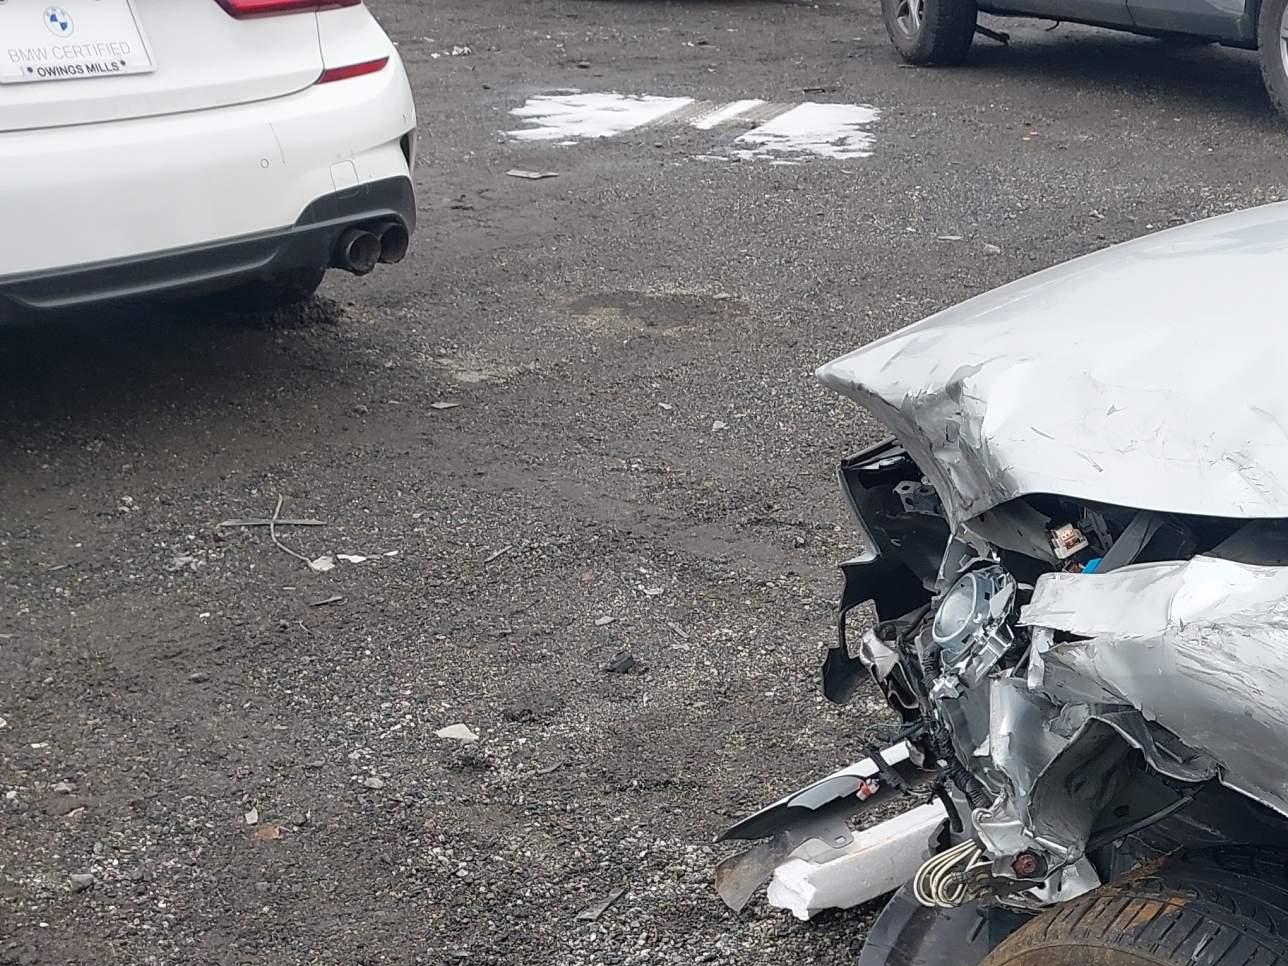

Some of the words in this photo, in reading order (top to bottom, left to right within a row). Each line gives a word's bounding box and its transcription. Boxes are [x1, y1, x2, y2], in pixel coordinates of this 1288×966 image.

[7, 48, 47, 63] BMW
[52, 41, 130, 60] CERTIFIED
[37, 65, 84, 77] OWINGS
[85, 61, 120, 74] MILLS
